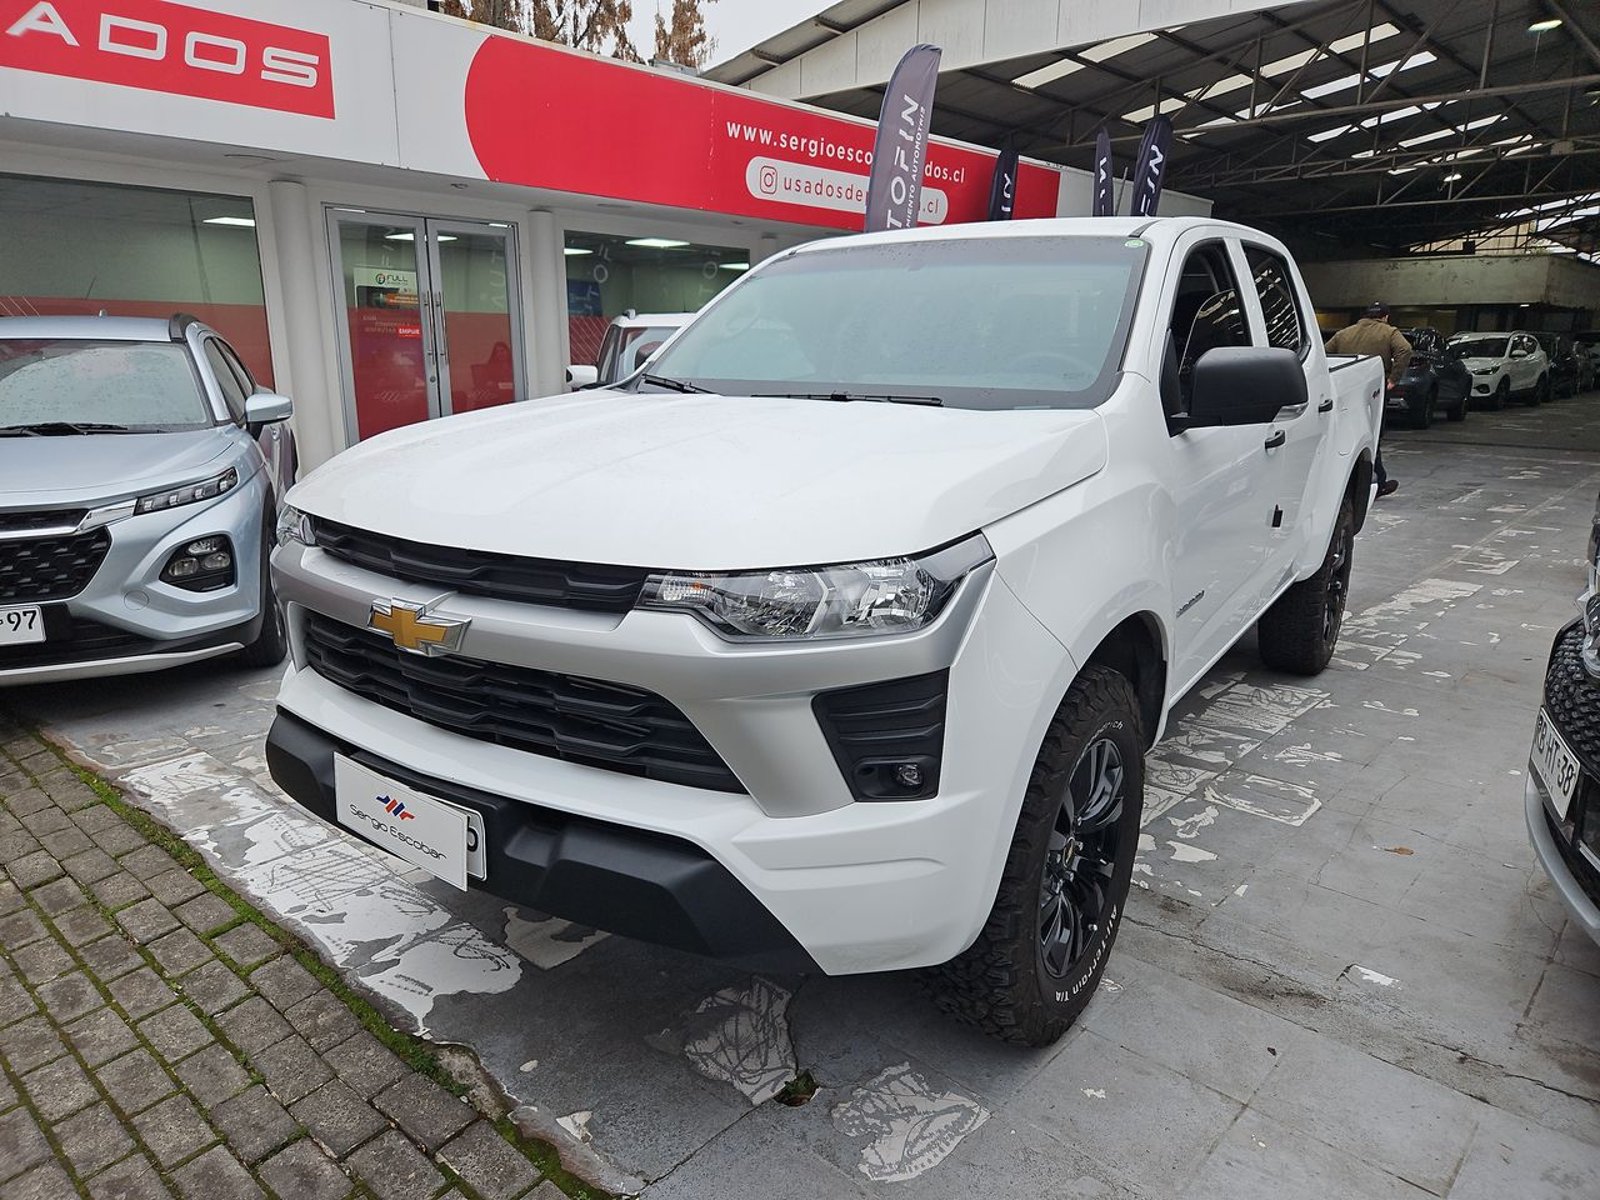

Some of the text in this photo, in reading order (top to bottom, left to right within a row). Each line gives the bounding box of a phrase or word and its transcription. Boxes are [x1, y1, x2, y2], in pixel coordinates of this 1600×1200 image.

[5, 0, 320, 88] ADOS
[886, 94, 919, 228] TOFIN
[905, 184, 916, 228] MIENTO
[389, 825, 447, 860] Escobar
